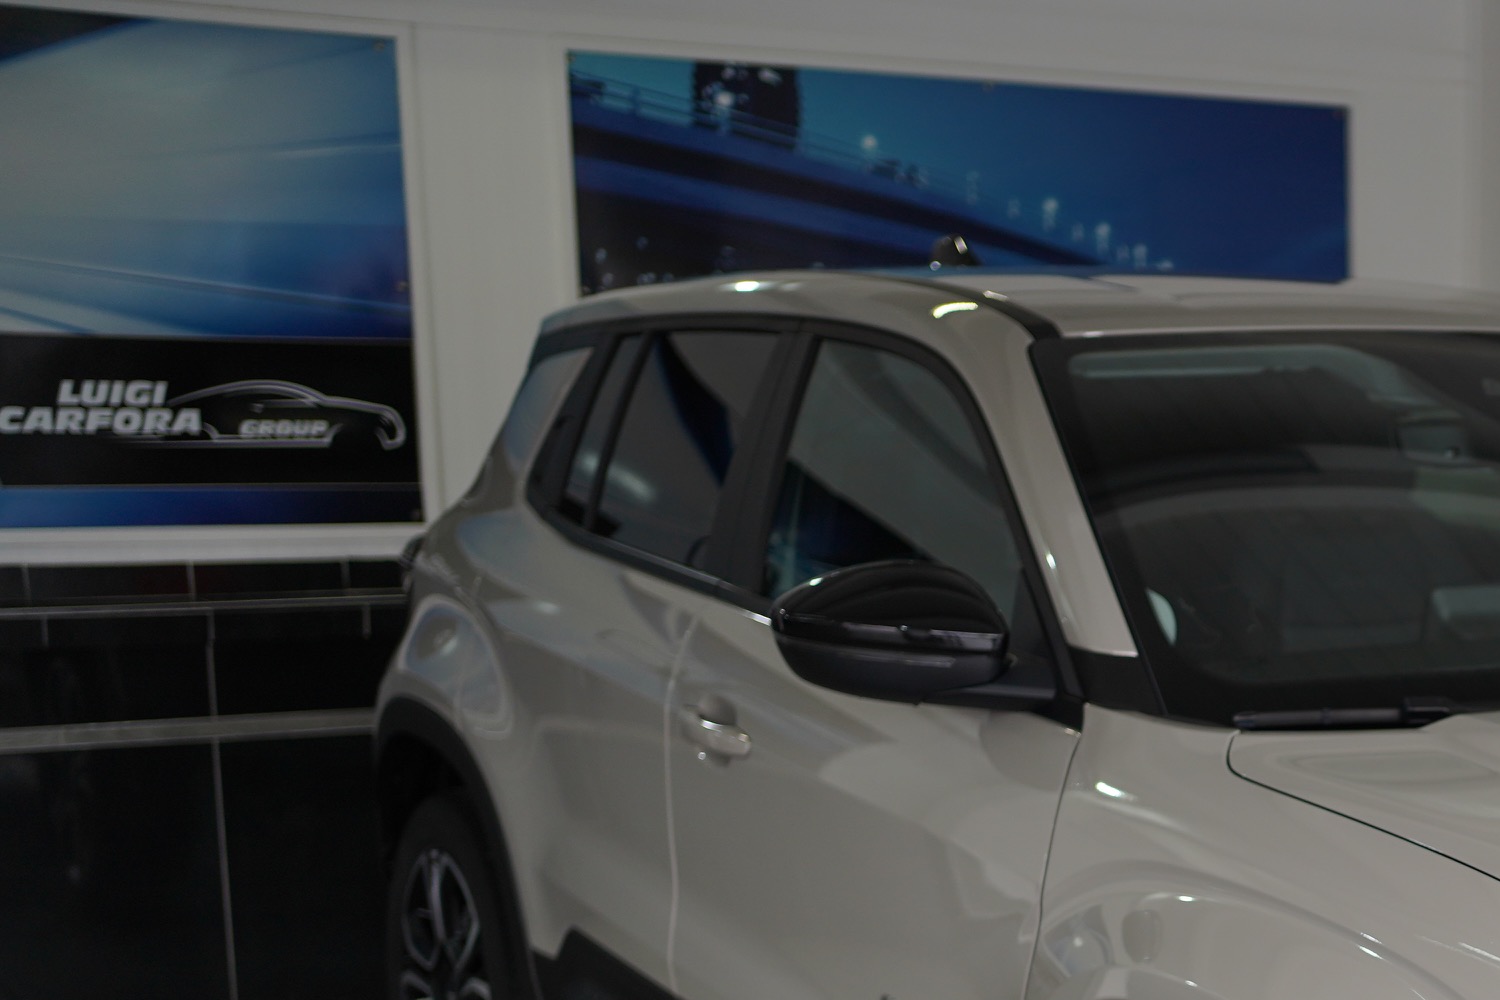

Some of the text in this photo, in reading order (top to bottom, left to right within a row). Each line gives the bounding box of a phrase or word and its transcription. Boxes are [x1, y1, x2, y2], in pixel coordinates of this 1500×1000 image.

[57, 379, 169, 408] LUIGI
[0, 405, 330, 438] CARFORA GROUP
